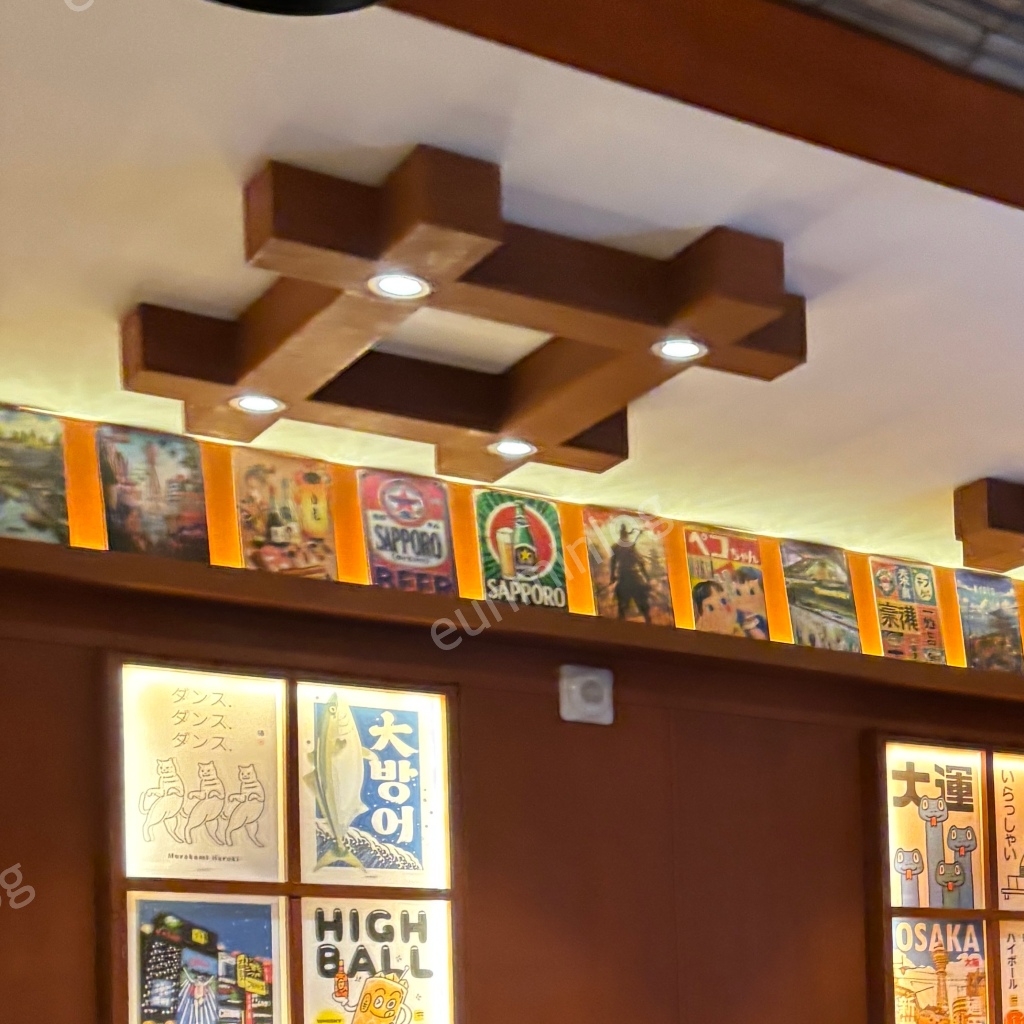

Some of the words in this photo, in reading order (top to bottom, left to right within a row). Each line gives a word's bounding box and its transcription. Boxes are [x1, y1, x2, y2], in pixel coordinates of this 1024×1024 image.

[373, 524, 441, 558] SAPPORO
[689, 531, 760, 564] ペコちゃん
[486, 579, 566, 608] SAPPORO
[892, 761, 974, 812] 大運
[314, 907, 428, 943] HIGH
[895, 922, 980, 952] OSAKA
[316, 943, 434, 978] BALL
